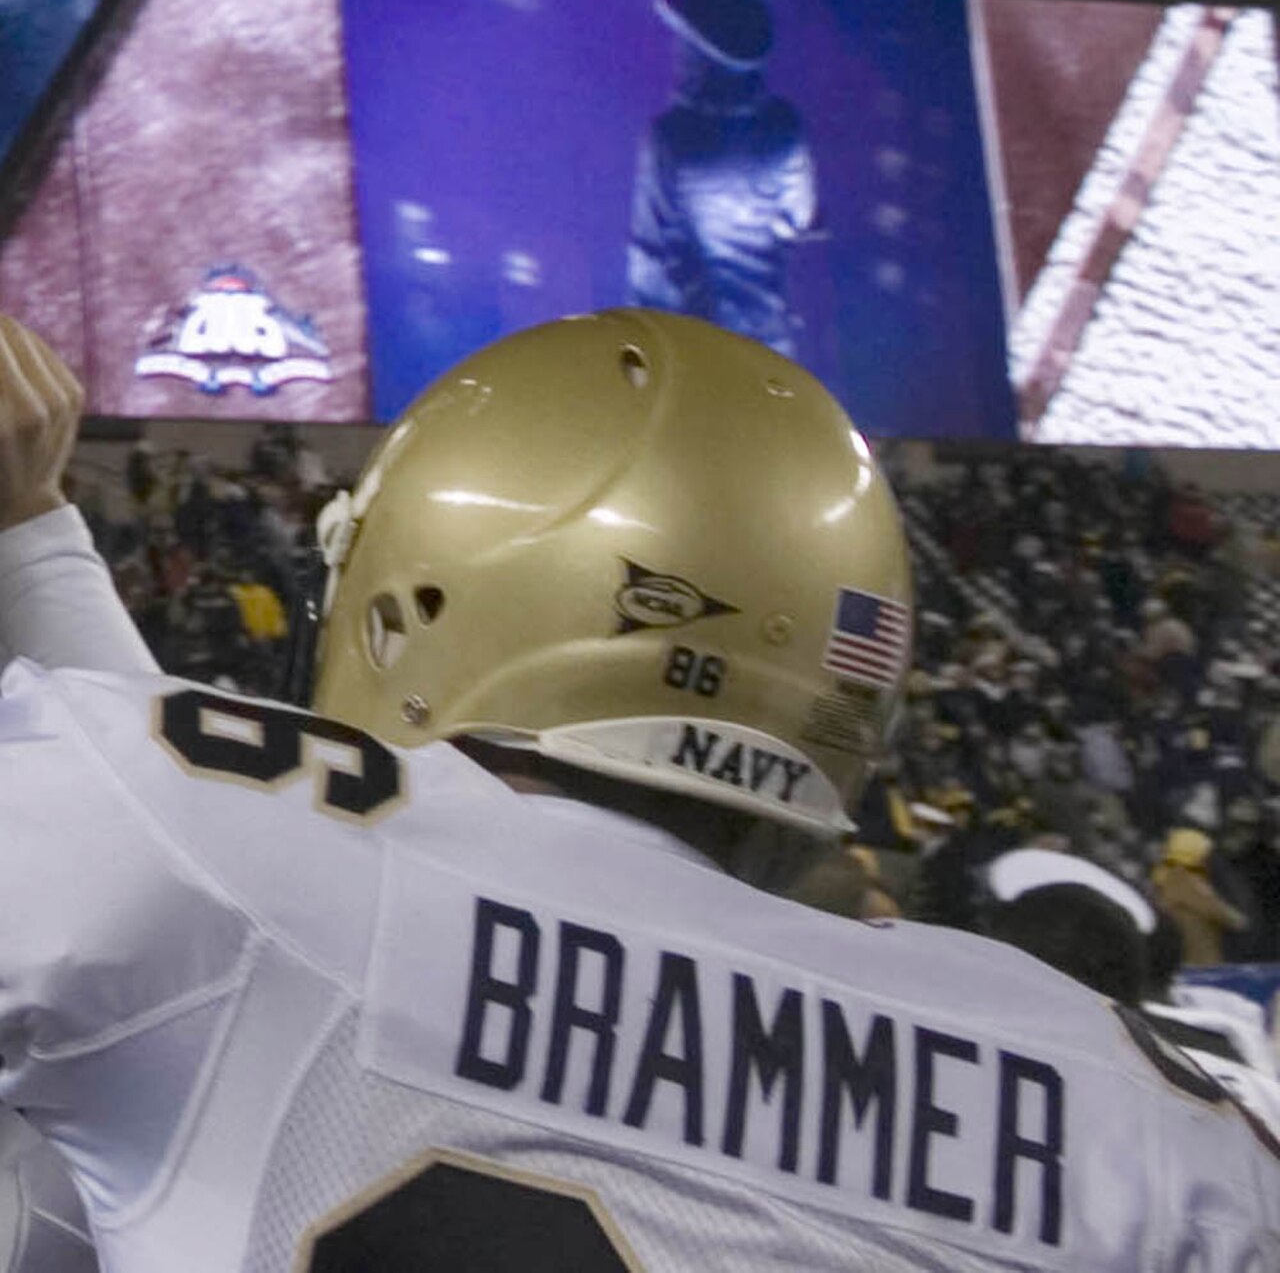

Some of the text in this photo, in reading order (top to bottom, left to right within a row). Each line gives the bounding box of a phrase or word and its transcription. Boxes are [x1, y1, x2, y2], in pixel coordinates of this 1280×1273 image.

[664, 644, 726, 698] 86
[671, 724, 812, 803] NAVY
[453, 895, 1068, 1249] BRAMMER
